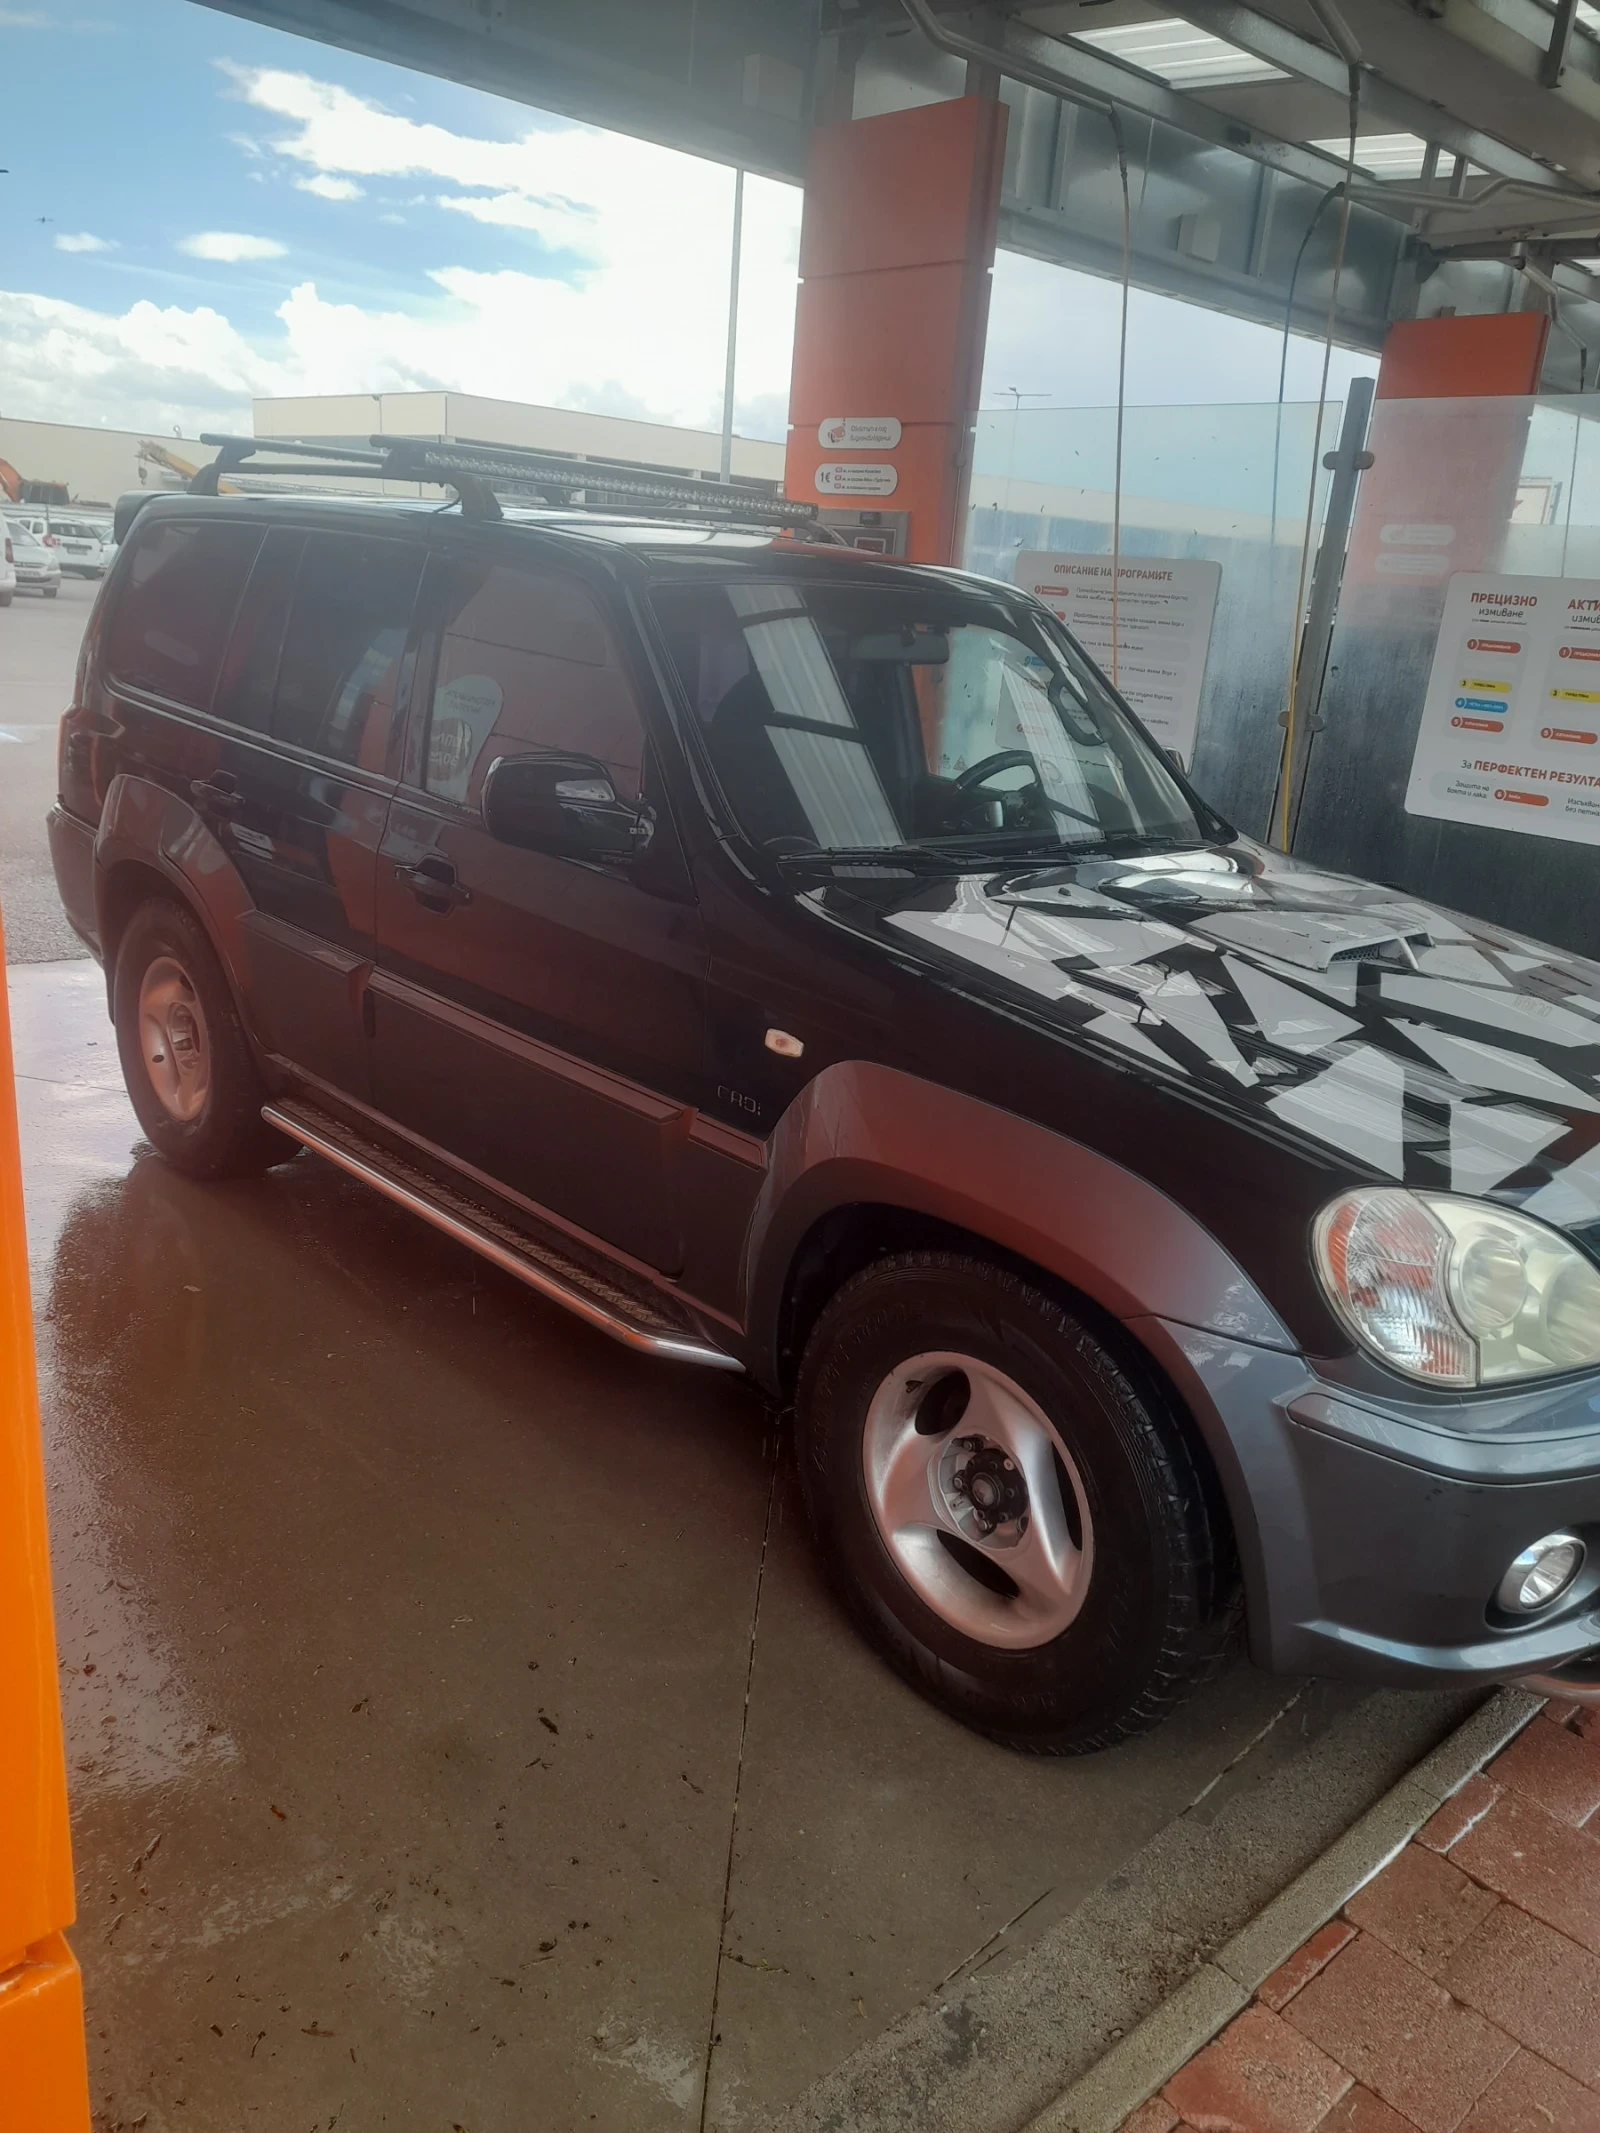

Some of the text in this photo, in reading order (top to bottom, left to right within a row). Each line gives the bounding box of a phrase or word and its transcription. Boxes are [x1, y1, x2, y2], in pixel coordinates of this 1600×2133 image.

[1053, 564, 1100, 577] ОПИСАНИЕ
[1101, 567, 1112, 577] НА
[1471, 592, 1538, 607] ПРЕЦИЗНО
[1478, 607, 1524, 618] измиване
[1461, 759, 1600, 787] За ПЕРФЕКТЕН РЕЗУЛТА
[1455, 780, 1482, 790] Защита
[1447, 787, 1467, 796] боята
[1565, 805, 1576, 813] без
